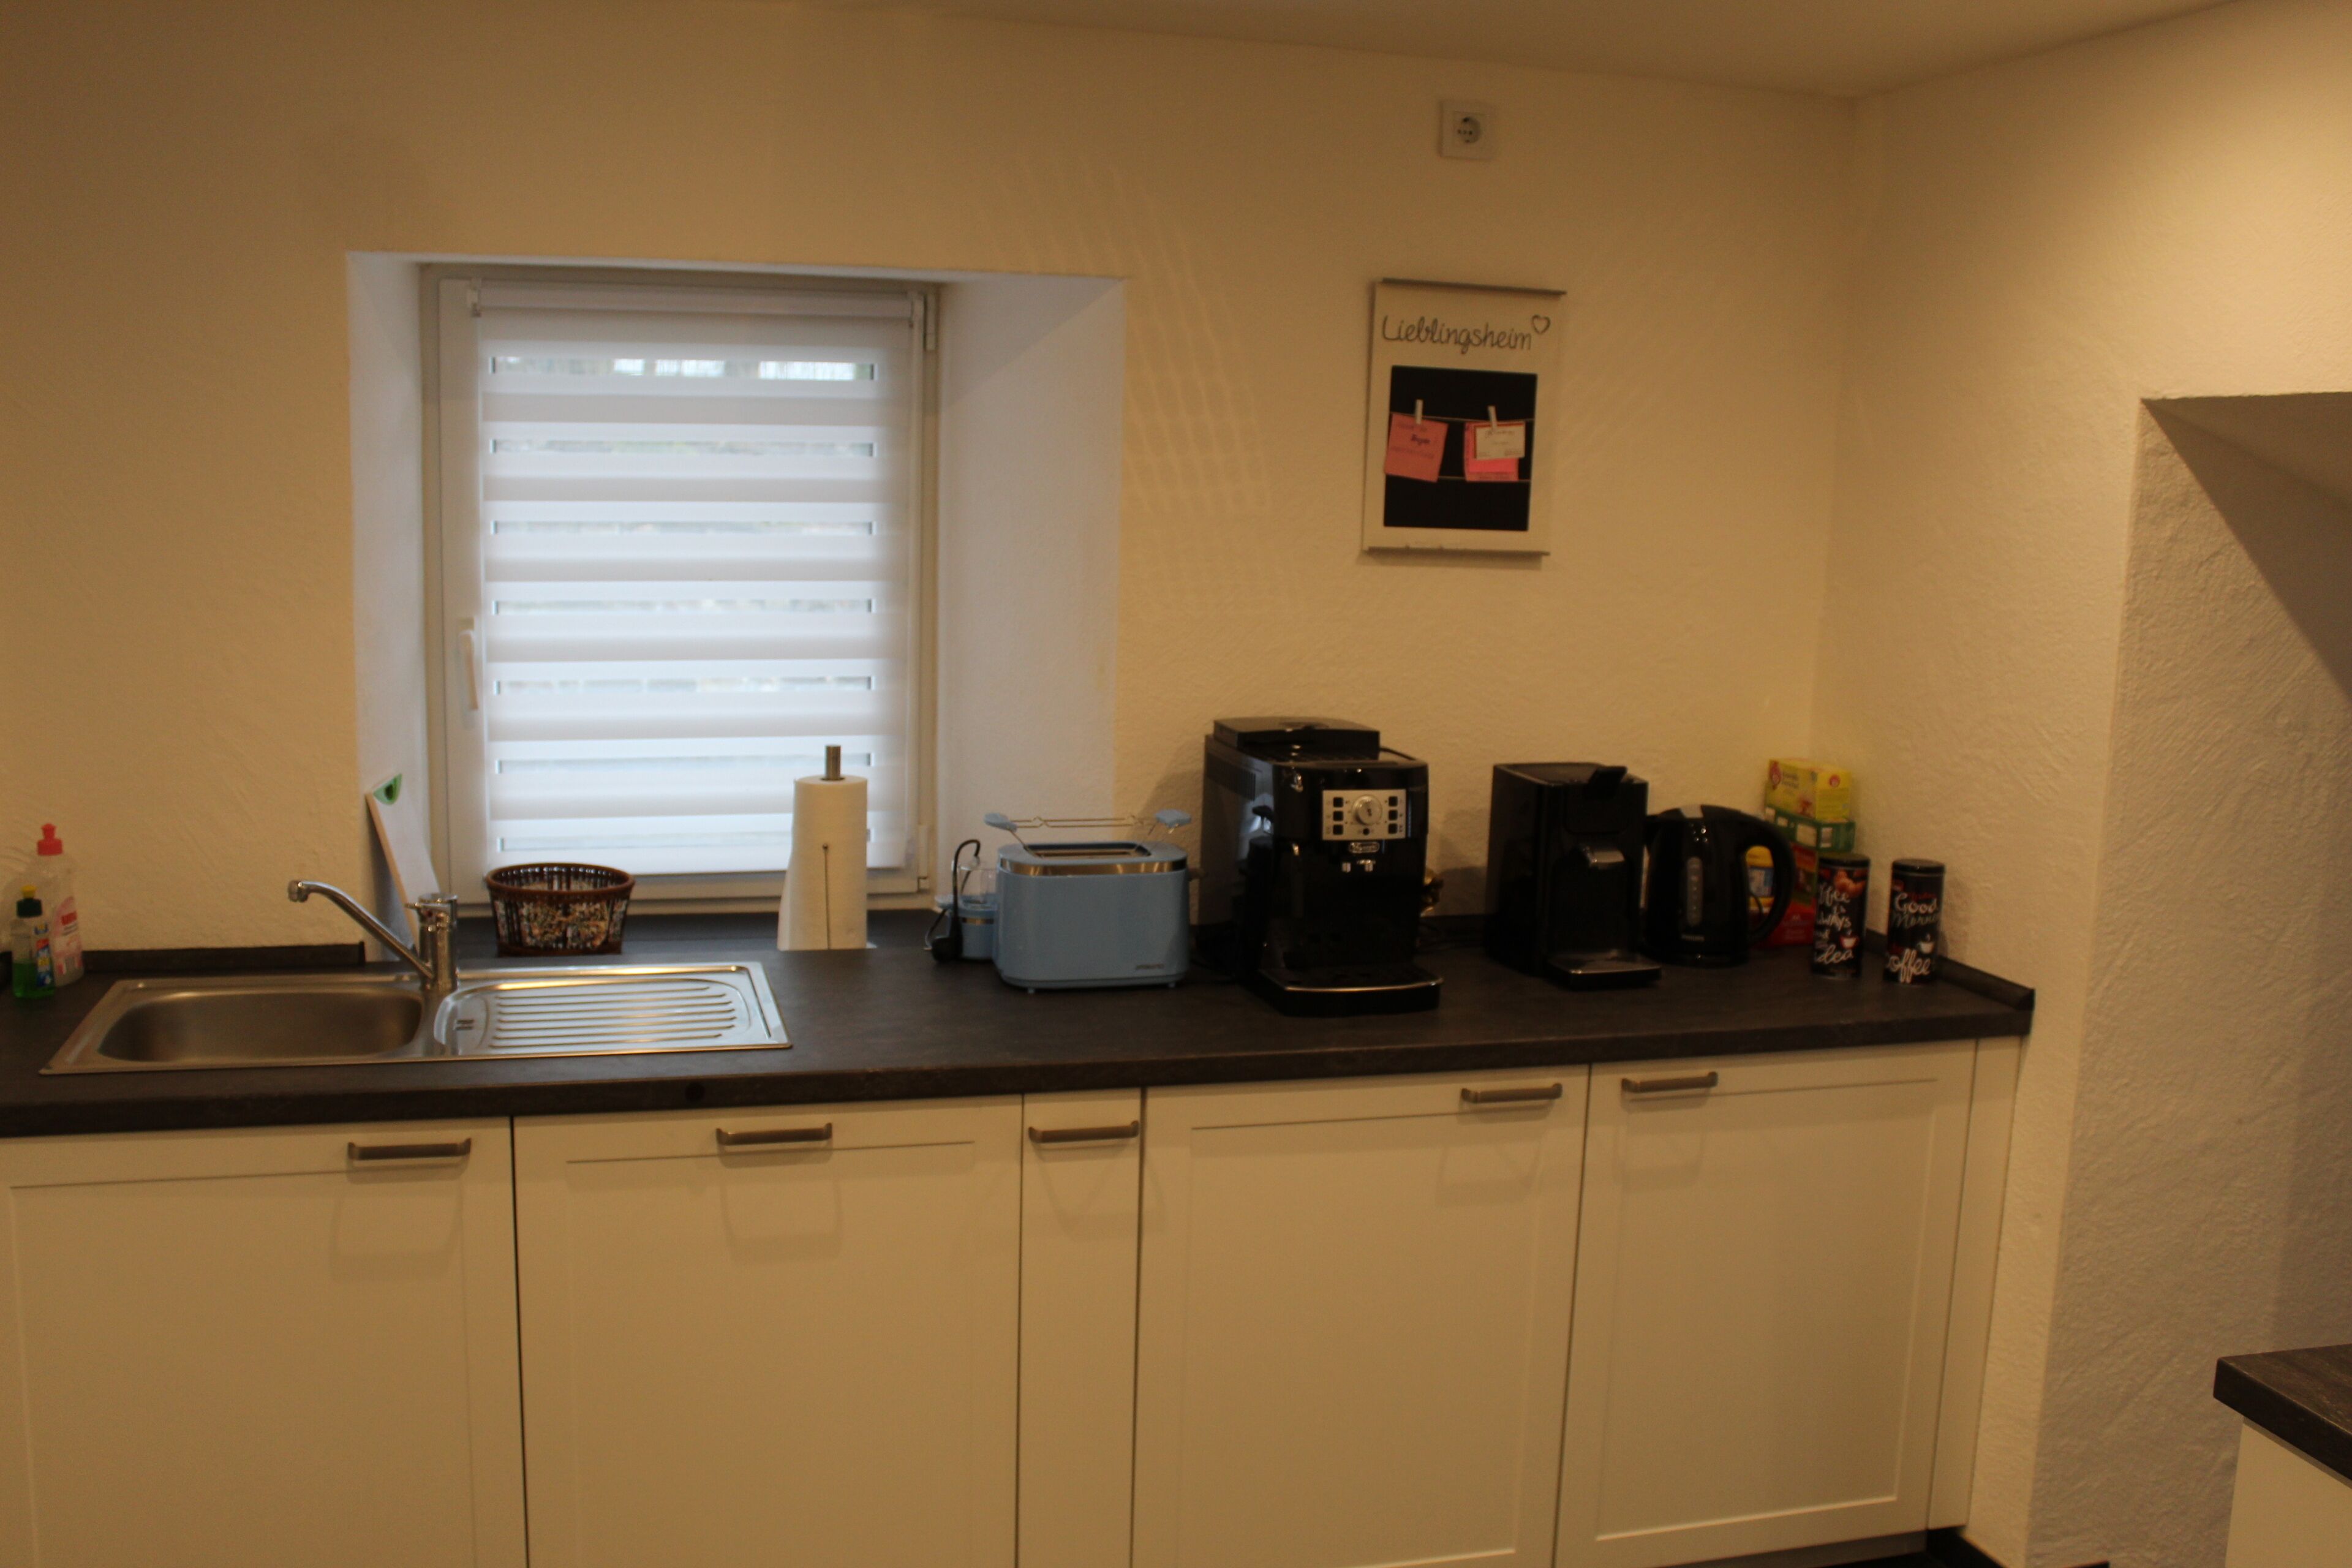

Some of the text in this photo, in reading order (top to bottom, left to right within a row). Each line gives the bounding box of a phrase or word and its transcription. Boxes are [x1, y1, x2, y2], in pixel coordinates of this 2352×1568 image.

[1382, 315, 1531, 354] Lieblingsheim
[1894, 892, 1937, 914] Good
[1887, 948, 1931, 984] offee
